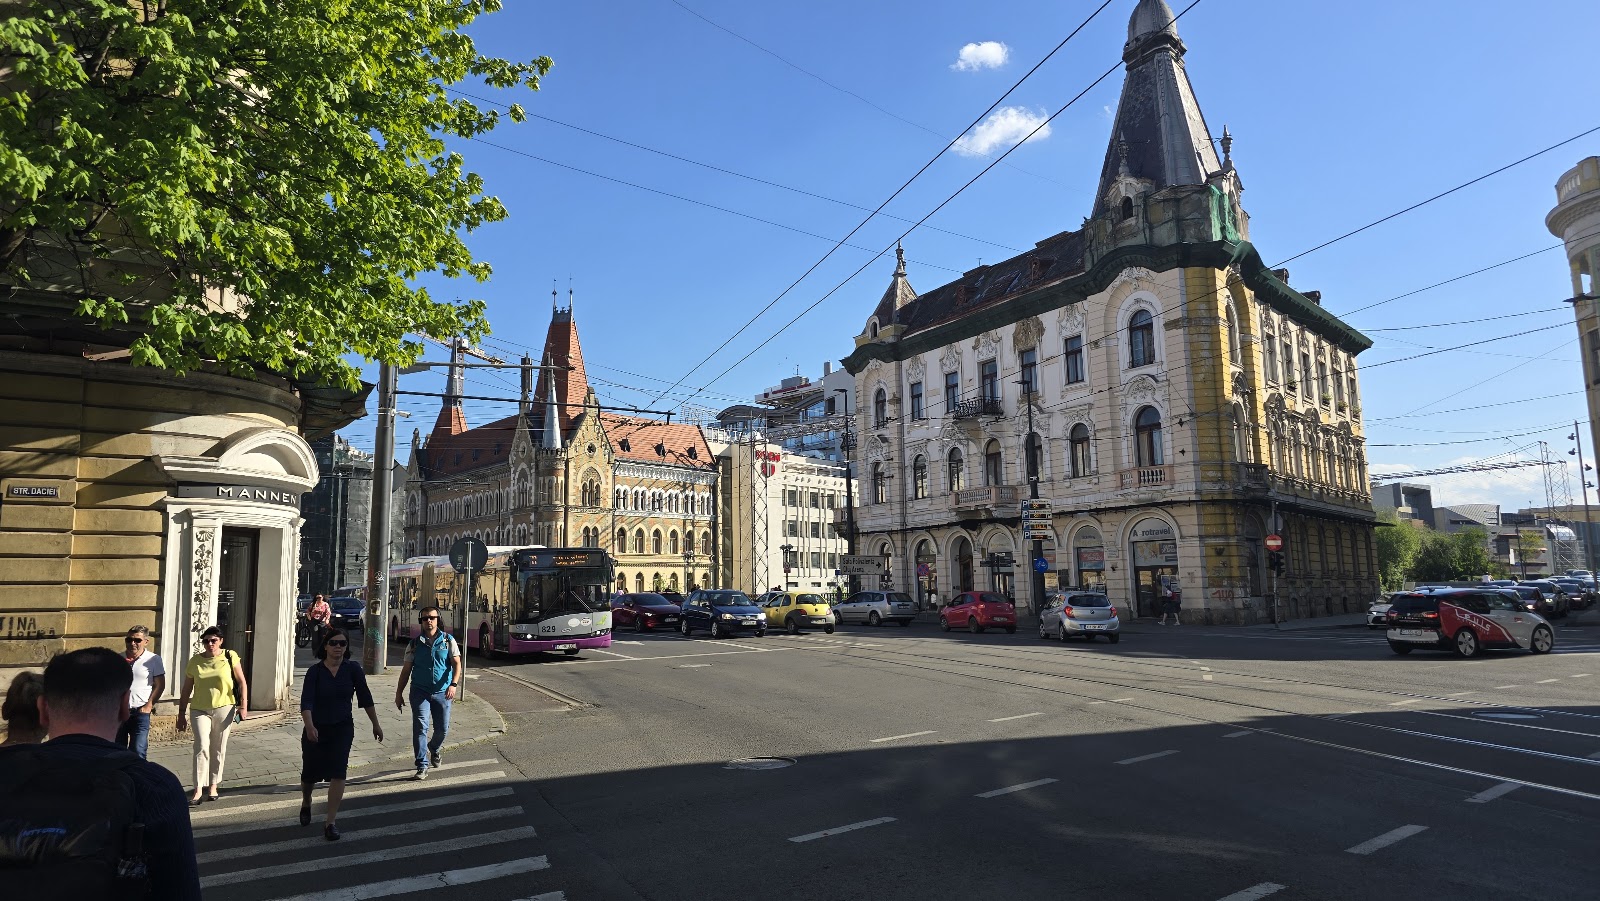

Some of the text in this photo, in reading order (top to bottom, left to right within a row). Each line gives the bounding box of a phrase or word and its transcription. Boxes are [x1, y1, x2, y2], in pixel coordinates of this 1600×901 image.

[13, 487, 56, 496] STR. DACIEI
[218, 486, 297, 504] MANNEN
[1132, 526, 1171, 537] Arotravel
[842, 565, 865, 574] Cluj Arena
[541, 625, 556, 633] 829
